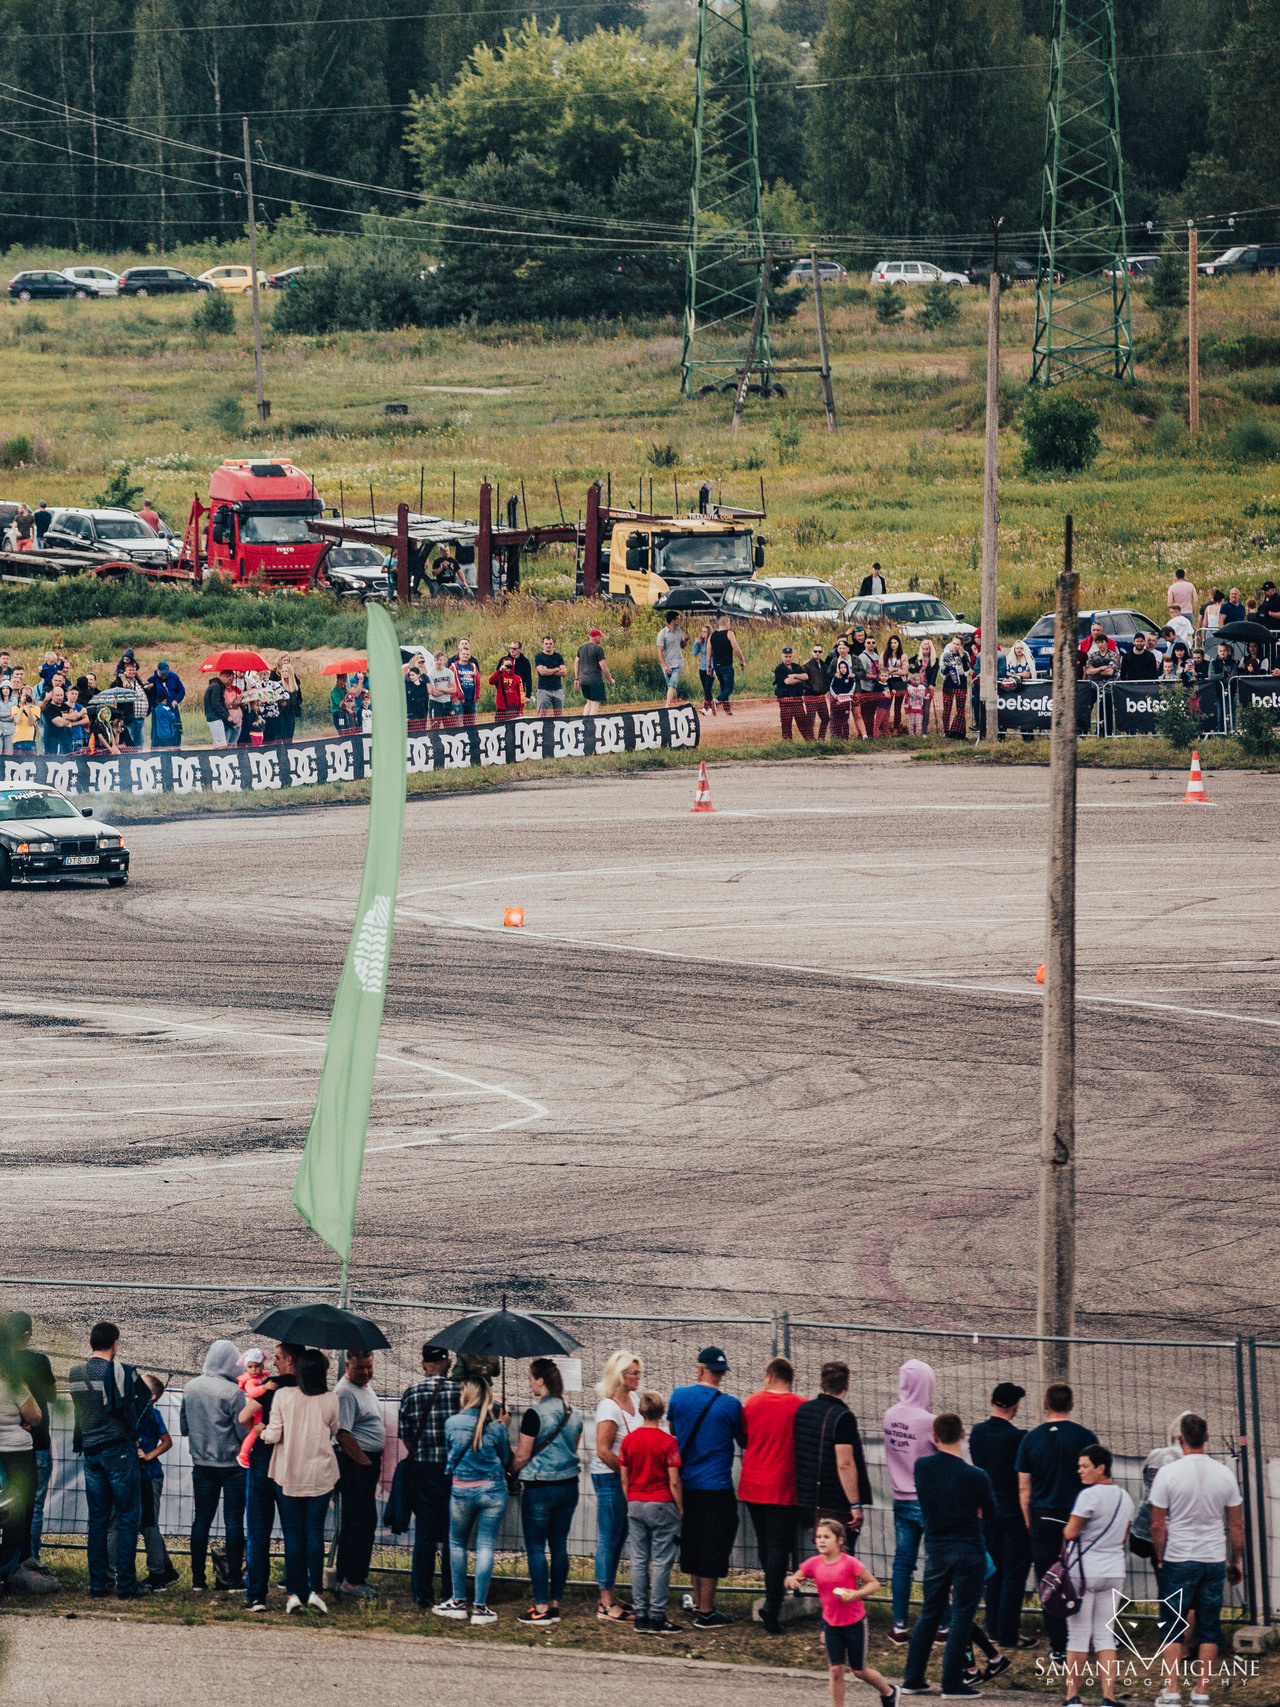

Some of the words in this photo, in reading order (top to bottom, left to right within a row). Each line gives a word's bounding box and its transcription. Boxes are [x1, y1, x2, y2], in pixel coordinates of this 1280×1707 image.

[997, 695, 1054, 711] betsafe
[66, 857, 82, 865] DTS
[85, 856, 99, 864] 032
[891, 1422, 909, 1430] INTER
[884, 1429, 917, 1440] NATIONAL
